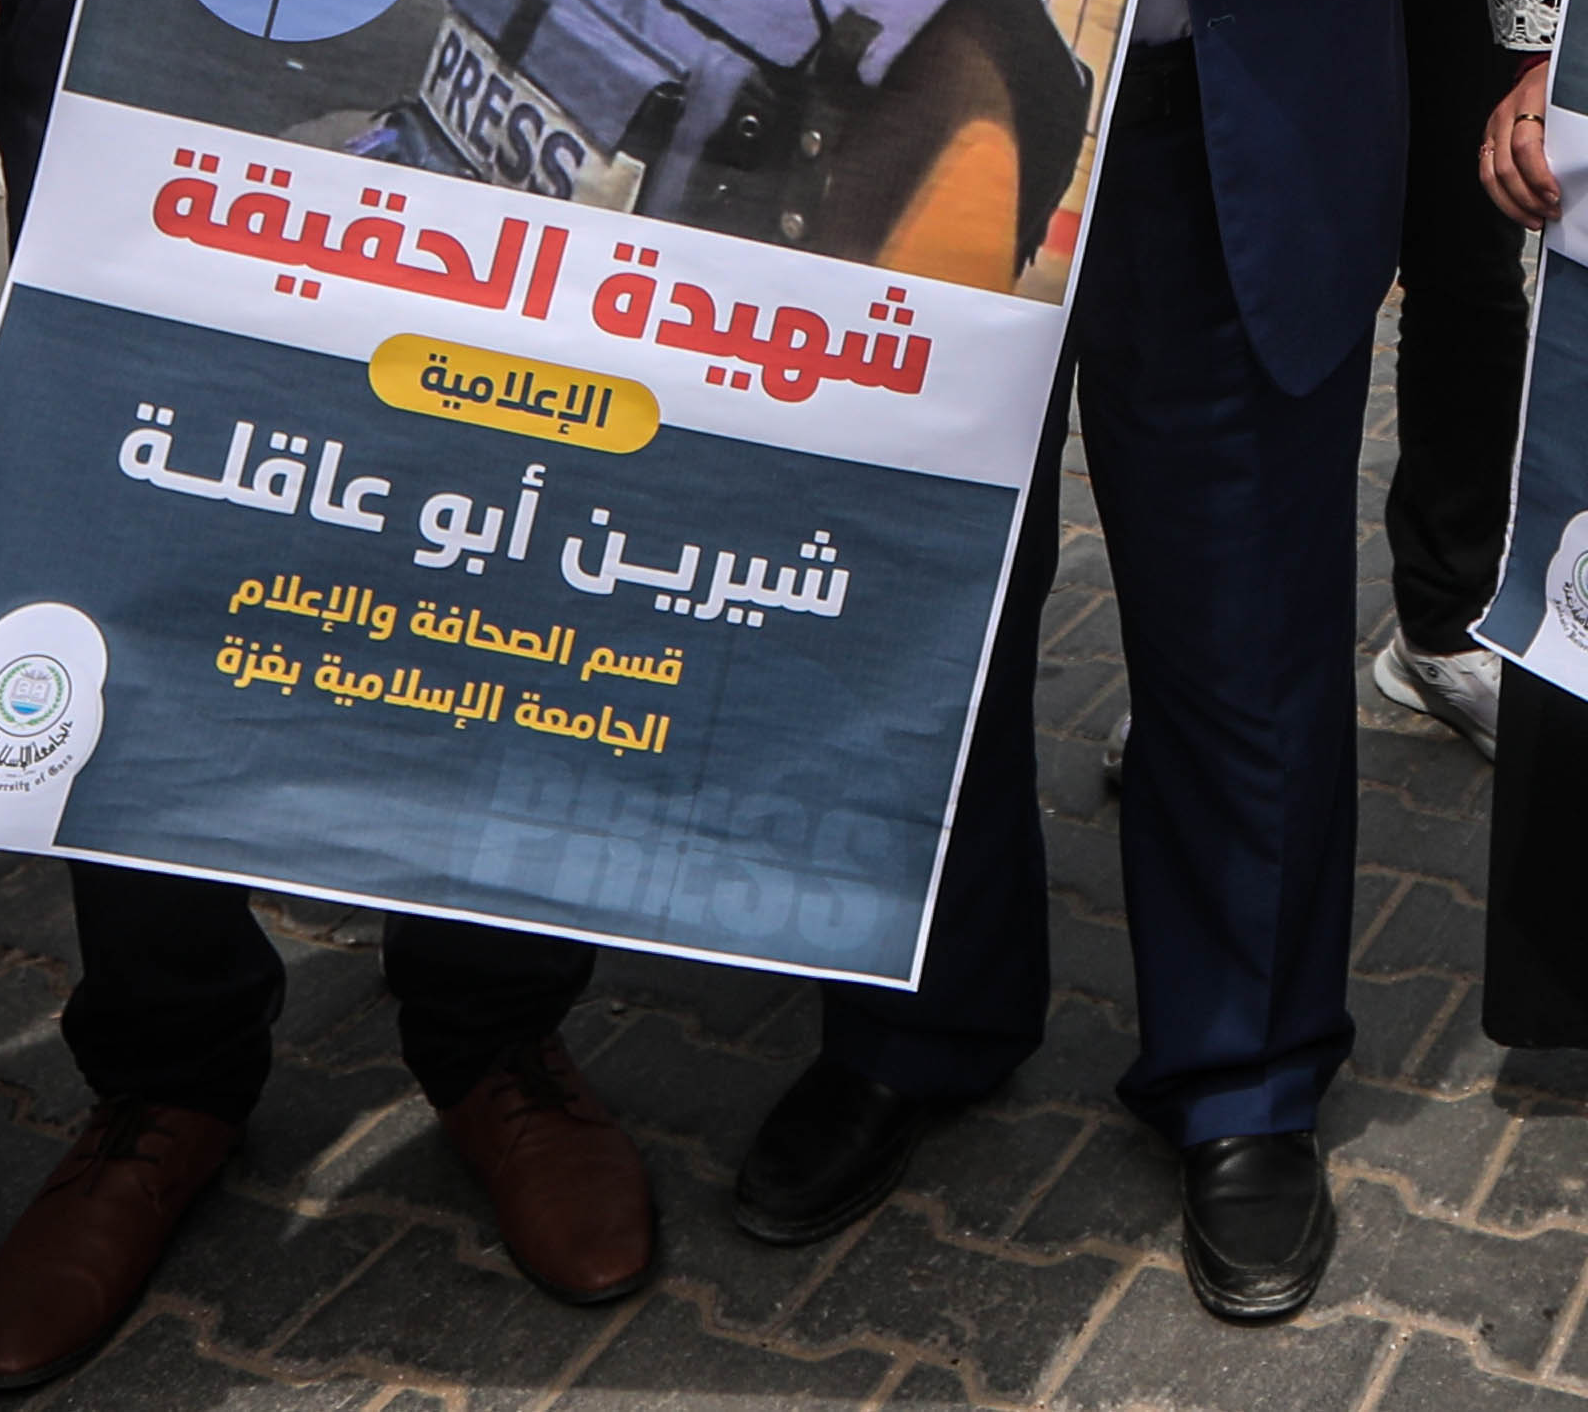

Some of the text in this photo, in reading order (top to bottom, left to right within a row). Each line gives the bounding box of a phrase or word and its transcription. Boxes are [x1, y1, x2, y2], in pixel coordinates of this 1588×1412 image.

[432, 28, 587, 201] PRESS
[154, 149, 932, 402] شهيدة الحقيقة
[421, 353, 612, 434] الإعلامية
[119, 404, 849, 627] شيرين أبو عاقلة
[215, 635, 671, 757] الجامعة الإسلامية بغزة
[228, 575, 684, 685] قسم الصحافة والإعلام
